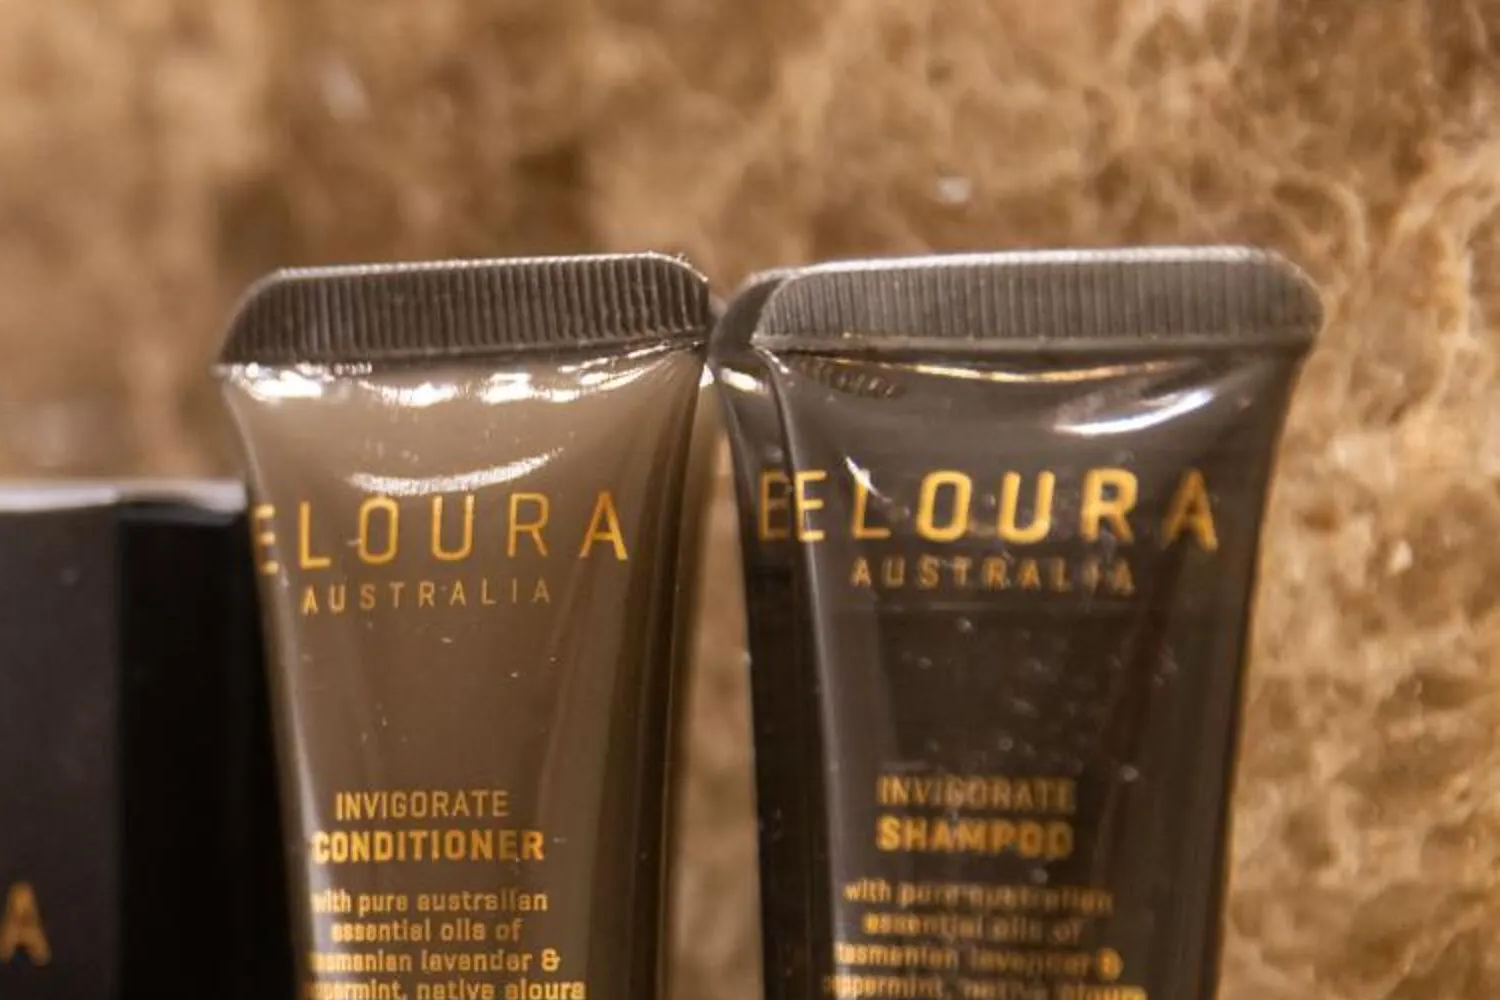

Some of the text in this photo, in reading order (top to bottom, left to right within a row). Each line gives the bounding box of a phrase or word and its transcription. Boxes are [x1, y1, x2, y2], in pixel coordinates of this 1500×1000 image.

[795, 468, 1219, 552] ELOURA
[254, 490, 628, 574] ELOURA
[852, 557, 1134, 595] AUSTRALIA
[303, 577, 551, 615] AUSTRALIA
[336, 791, 510, 820] INVIGORATE
[877, 774, 1076, 814] INVIGORATE
[311, 830, 545, 863] CONDITIONER
[876, 815, 1074, 860] SHAMPOO
[311, 889, 549, 918] with pure australian
[844, 878, 891, 903] with
[331, 918, 524, 943] essential oils of
[420, 948, 533, 972] lavender
[540, 947, 561, 972] &
